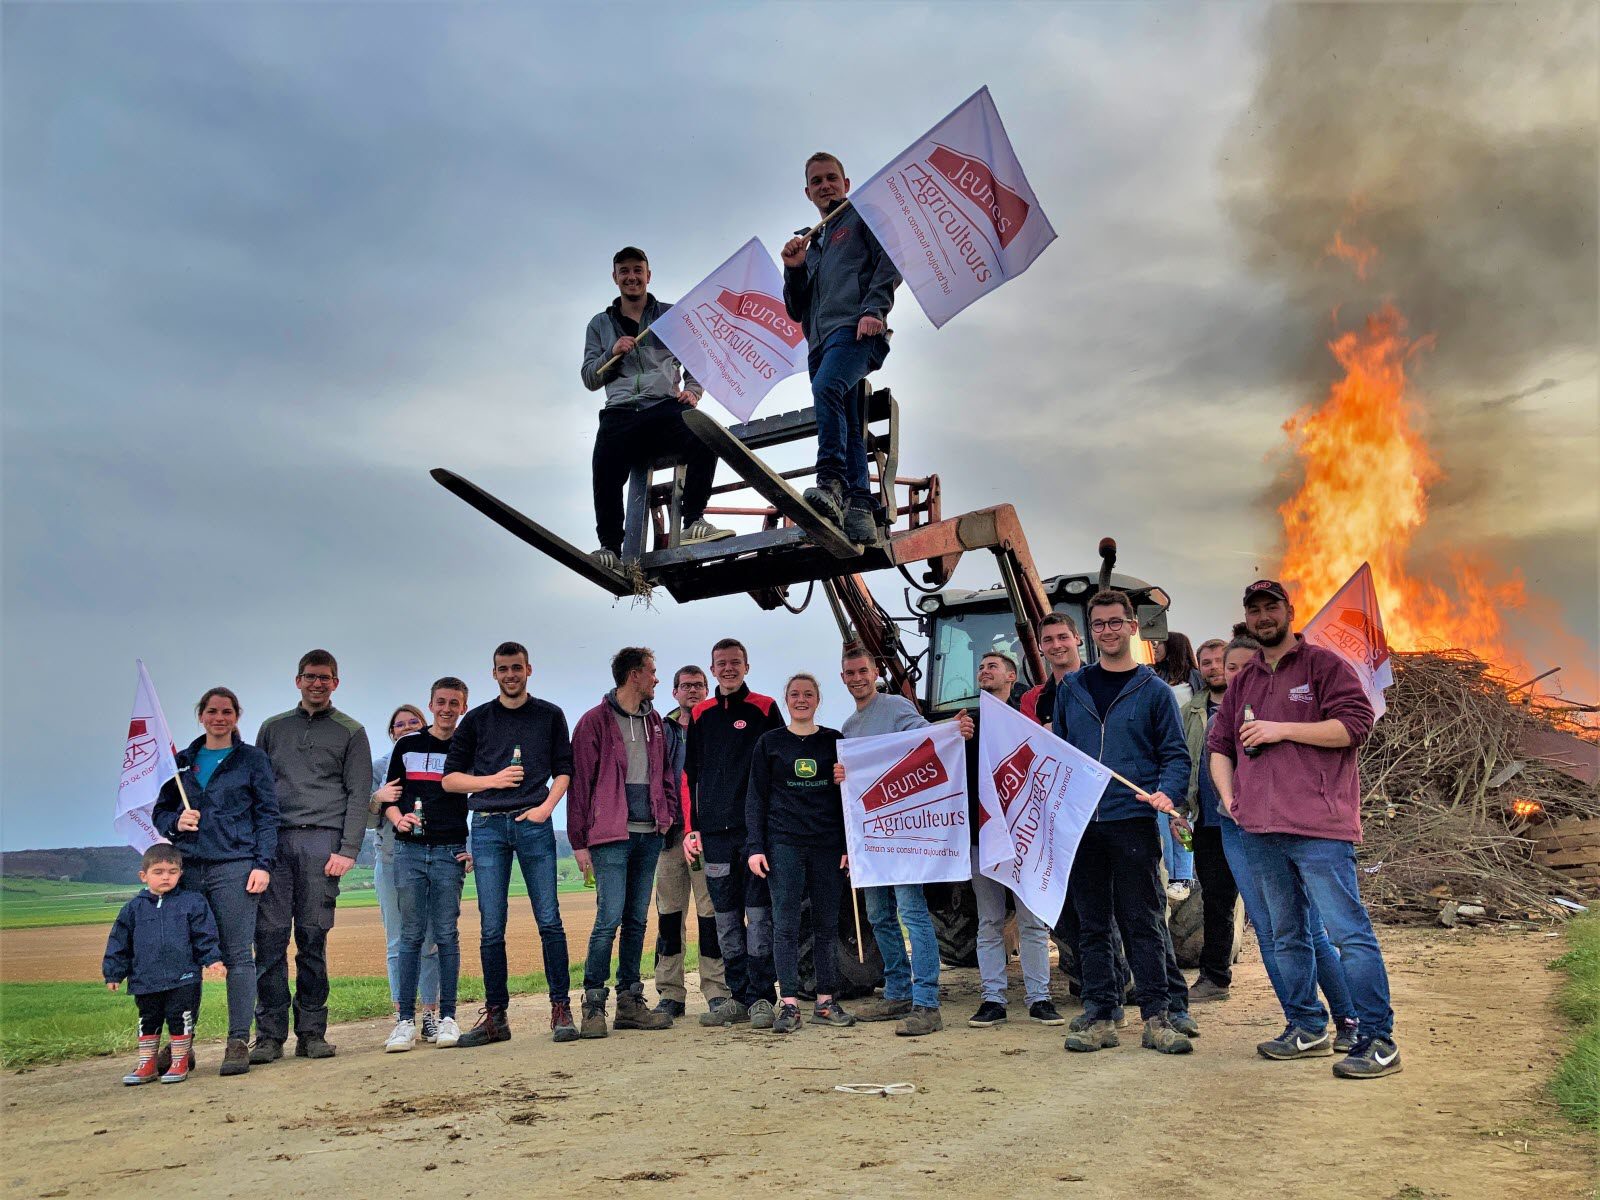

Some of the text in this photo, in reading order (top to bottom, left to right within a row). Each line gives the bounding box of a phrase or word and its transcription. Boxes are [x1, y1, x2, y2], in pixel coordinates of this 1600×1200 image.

[947, 161, 1012, 234] Jeunes
[886, 176, 953, 295] Demain se construit aujourd'hui
[911, 174, 993, 284] Agriculteurs
[682, 314, 703, 340] Demain
[701, 340, 709, 348] se
[735, 295, 797, 337] Jeunes
[421, 758, 444, 770] FIL
[879, 762, 938, 804] Jeunes
[872, 809, 965, 836] Agriculteurs
[864, 843, 885, 853] Demain
